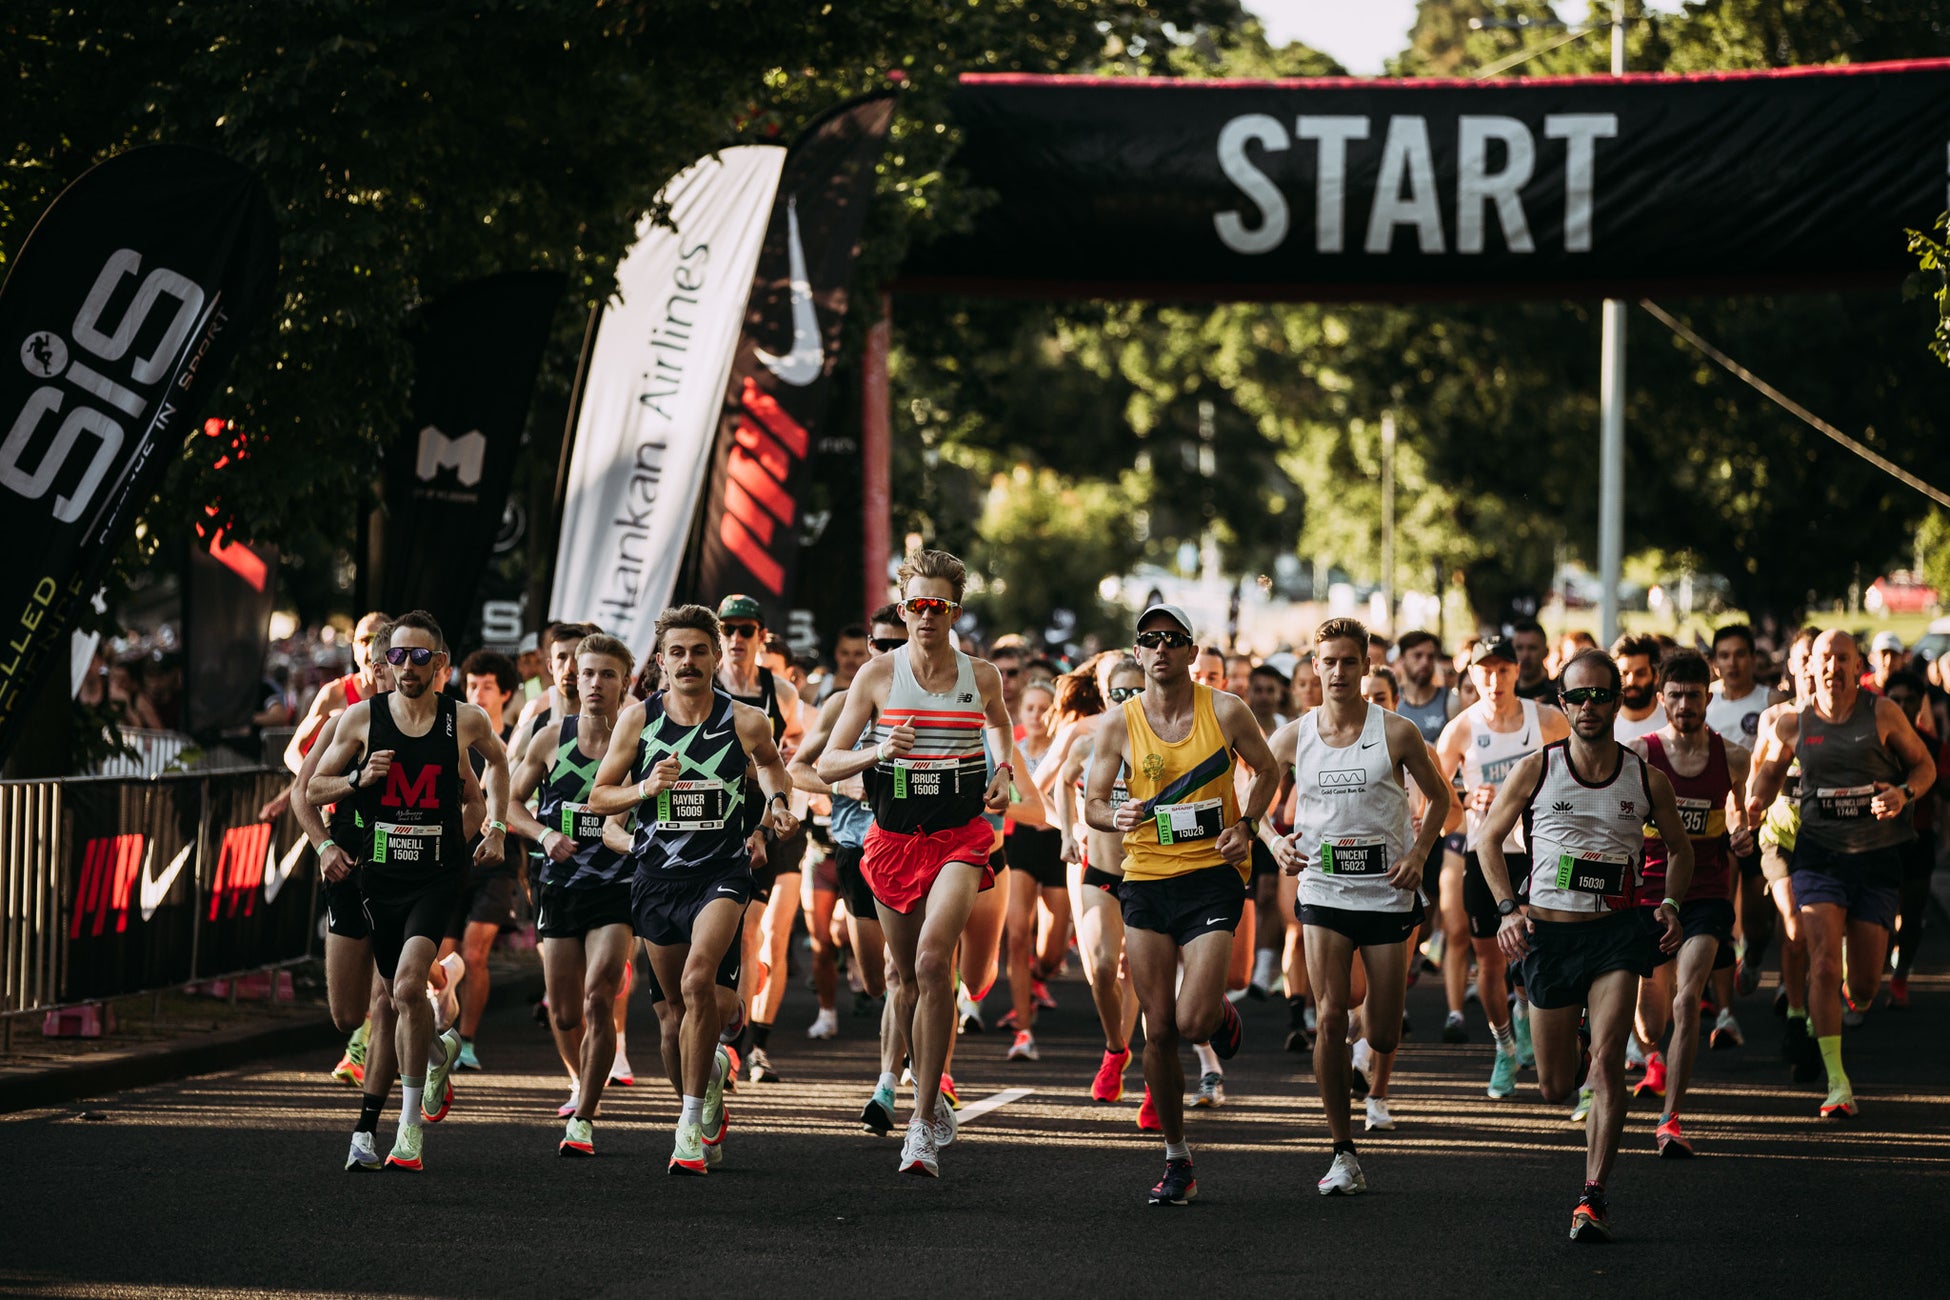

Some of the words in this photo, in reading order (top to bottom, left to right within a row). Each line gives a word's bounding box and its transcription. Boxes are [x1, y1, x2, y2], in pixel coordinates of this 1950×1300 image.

[1213, 113, 1618, 254] START
[640, 243, 708, 420] Airlines
[155, 402, 177, 430] IN
[178, 306, 230, 391] SPORT
[380, 761, 442, 809] M
[910, 773, 941, 784] JBRUCE
[913, 784, 940, 795] 15008
[672, 794, 705, 806] RAYNER
[676, 806, 703, 817] 15009
[581, 816, 600, 827] REID
[1160, 825, 1170, 844] ELITE
[1179, 825, 1204, 838] 15028
[388, 837, 424, 850] MCNEILL
[376, 842, 384, 861] ELITE
[393, 850, 419, 861] 15003
[1334, 850, 1368, 860] VINCENT
[1340, 860, 1366, 871] 15023
[1560, 867, 1568, 887] ELITE
[1578, 876, 1605, 890] 15030
